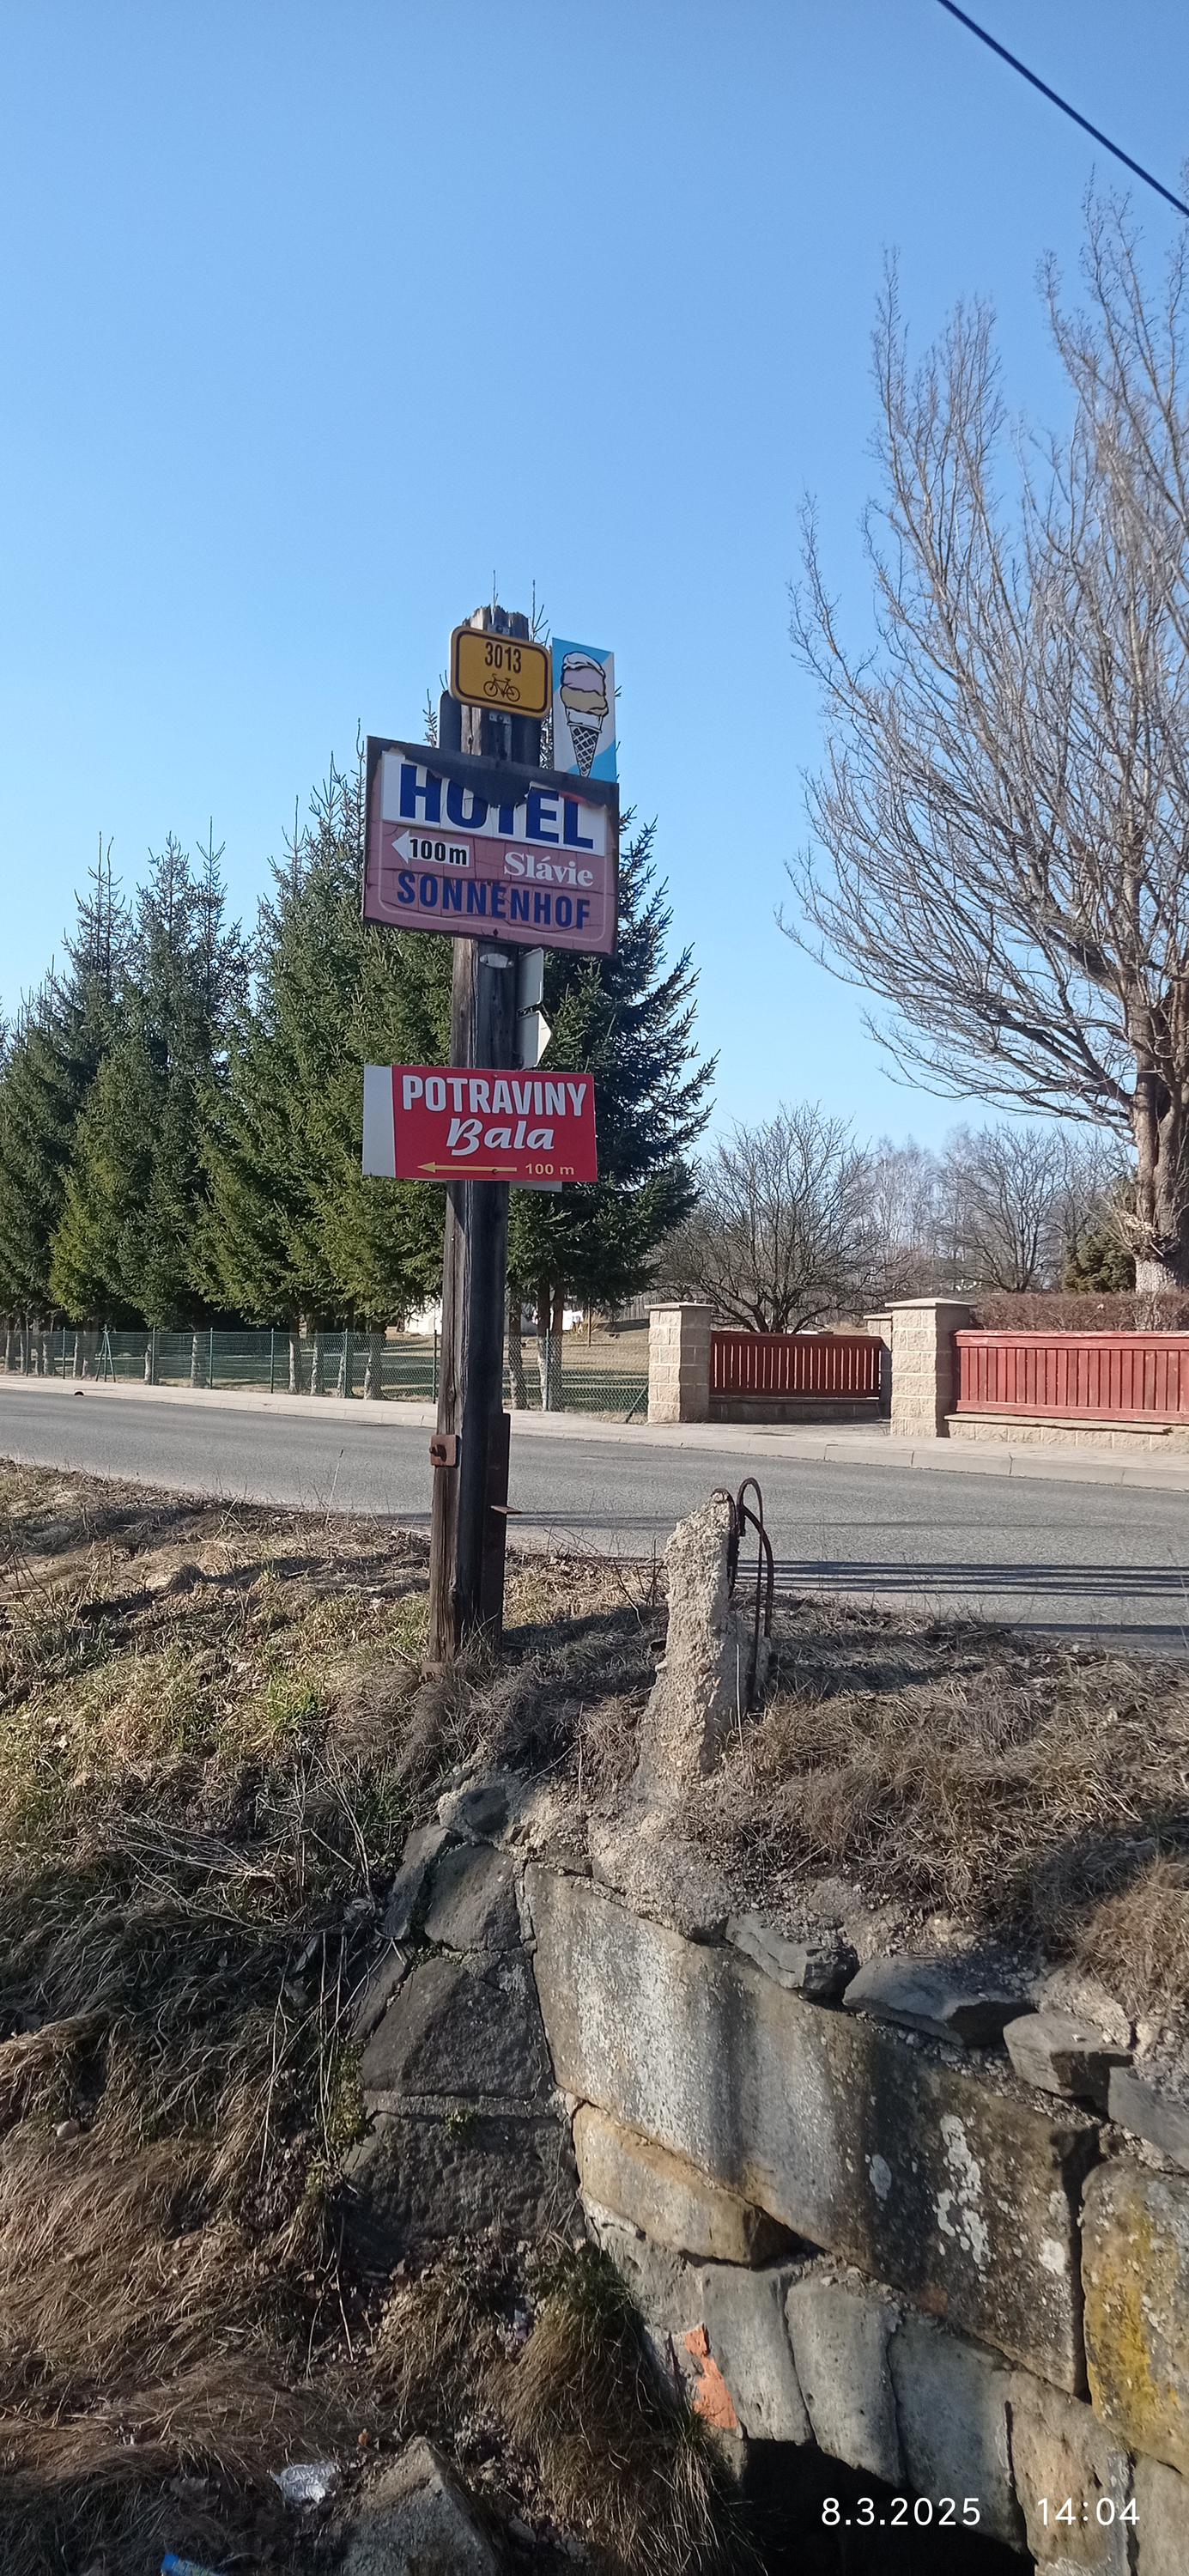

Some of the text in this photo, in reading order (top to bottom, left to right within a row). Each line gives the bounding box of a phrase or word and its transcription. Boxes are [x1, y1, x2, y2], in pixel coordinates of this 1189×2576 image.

[484, 641, 522, 674] 3013
[409, 838, 467, 866] 100m
[504, 851, 594, 887] Slávie
[397, 871, 591, 930] SONNENHOF
[402, 1075, 587, 1116] POTRAVINY
[446, 1117, 555, 1156] Bala
[525, 1163, 574, 1176] 100 m
